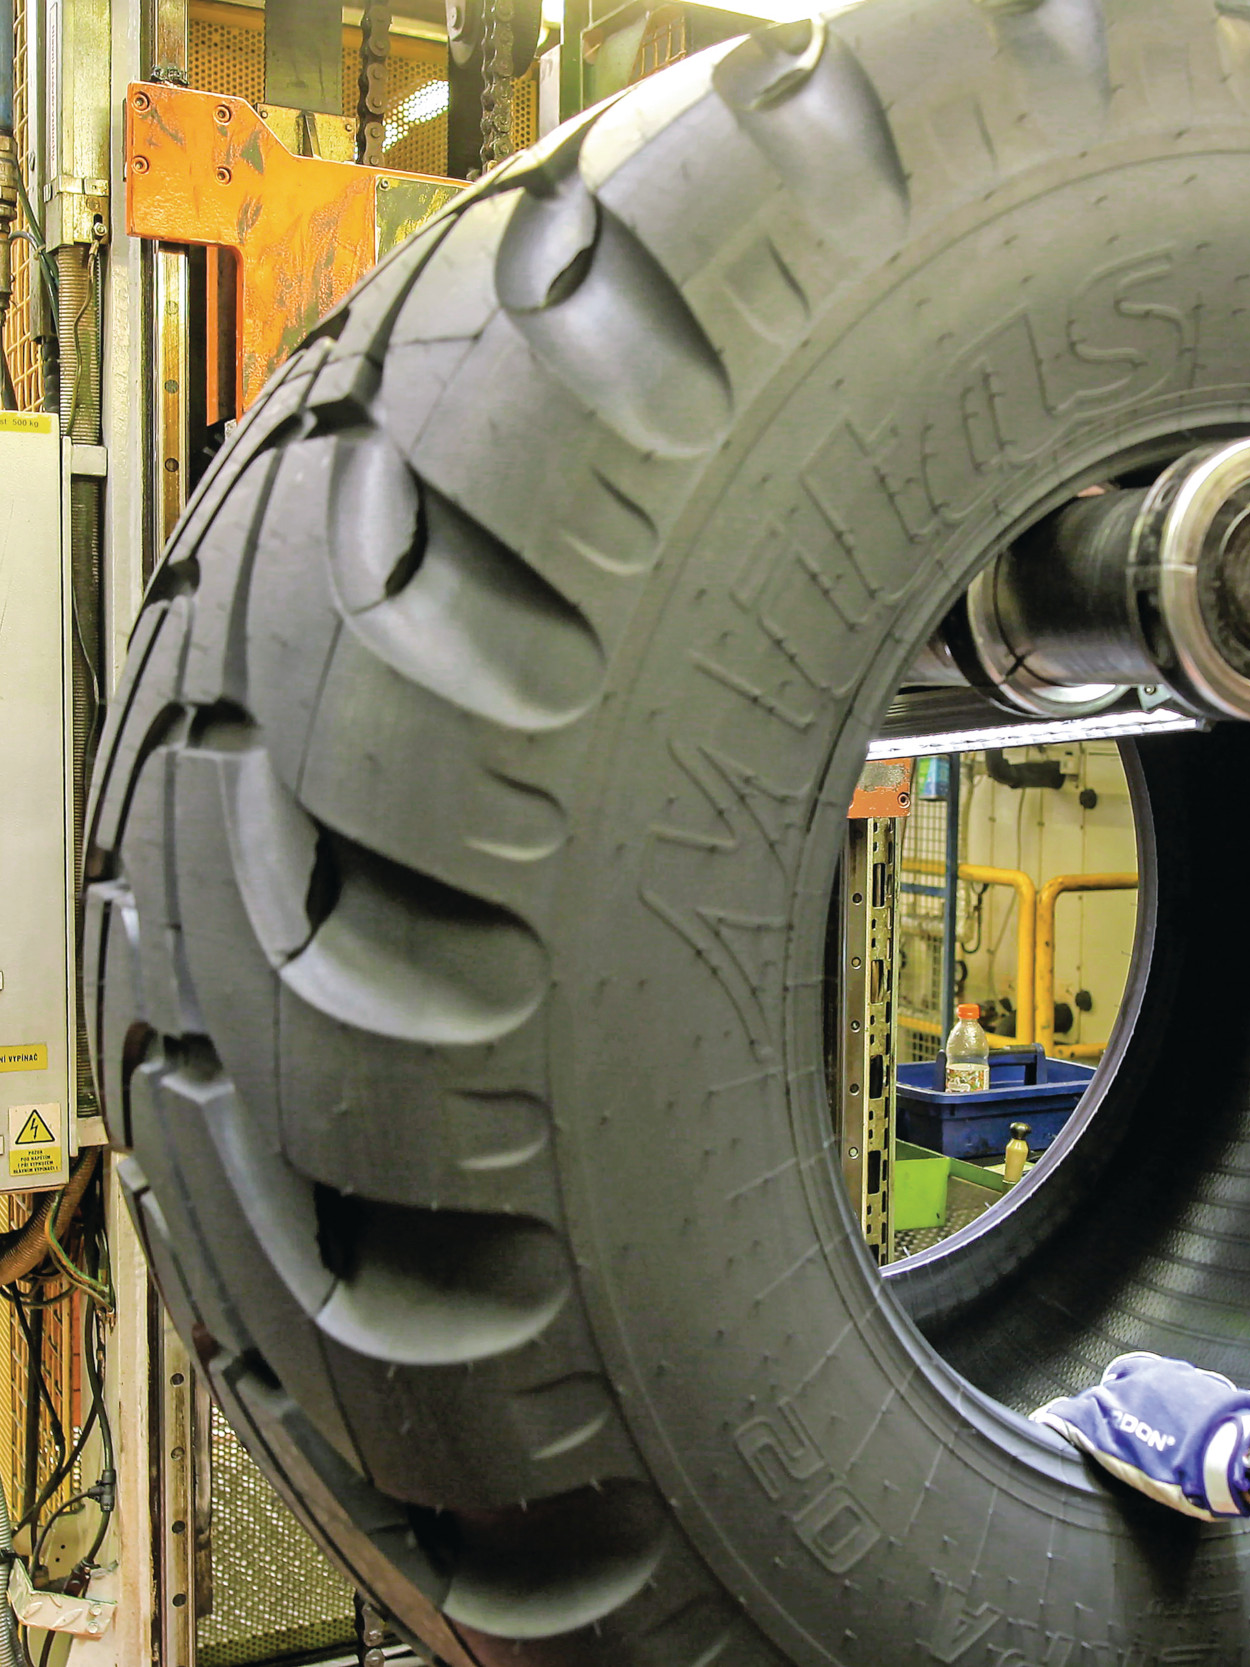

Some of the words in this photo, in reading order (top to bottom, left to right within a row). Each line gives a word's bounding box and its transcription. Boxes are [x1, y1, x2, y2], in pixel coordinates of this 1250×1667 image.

[12, 418, 27, 427] 500
[29, 420, 39, 428] kg
[8, 1052, 38, 1063] VYPÍNAČ
[734, 1397, 883, 1575] 02
